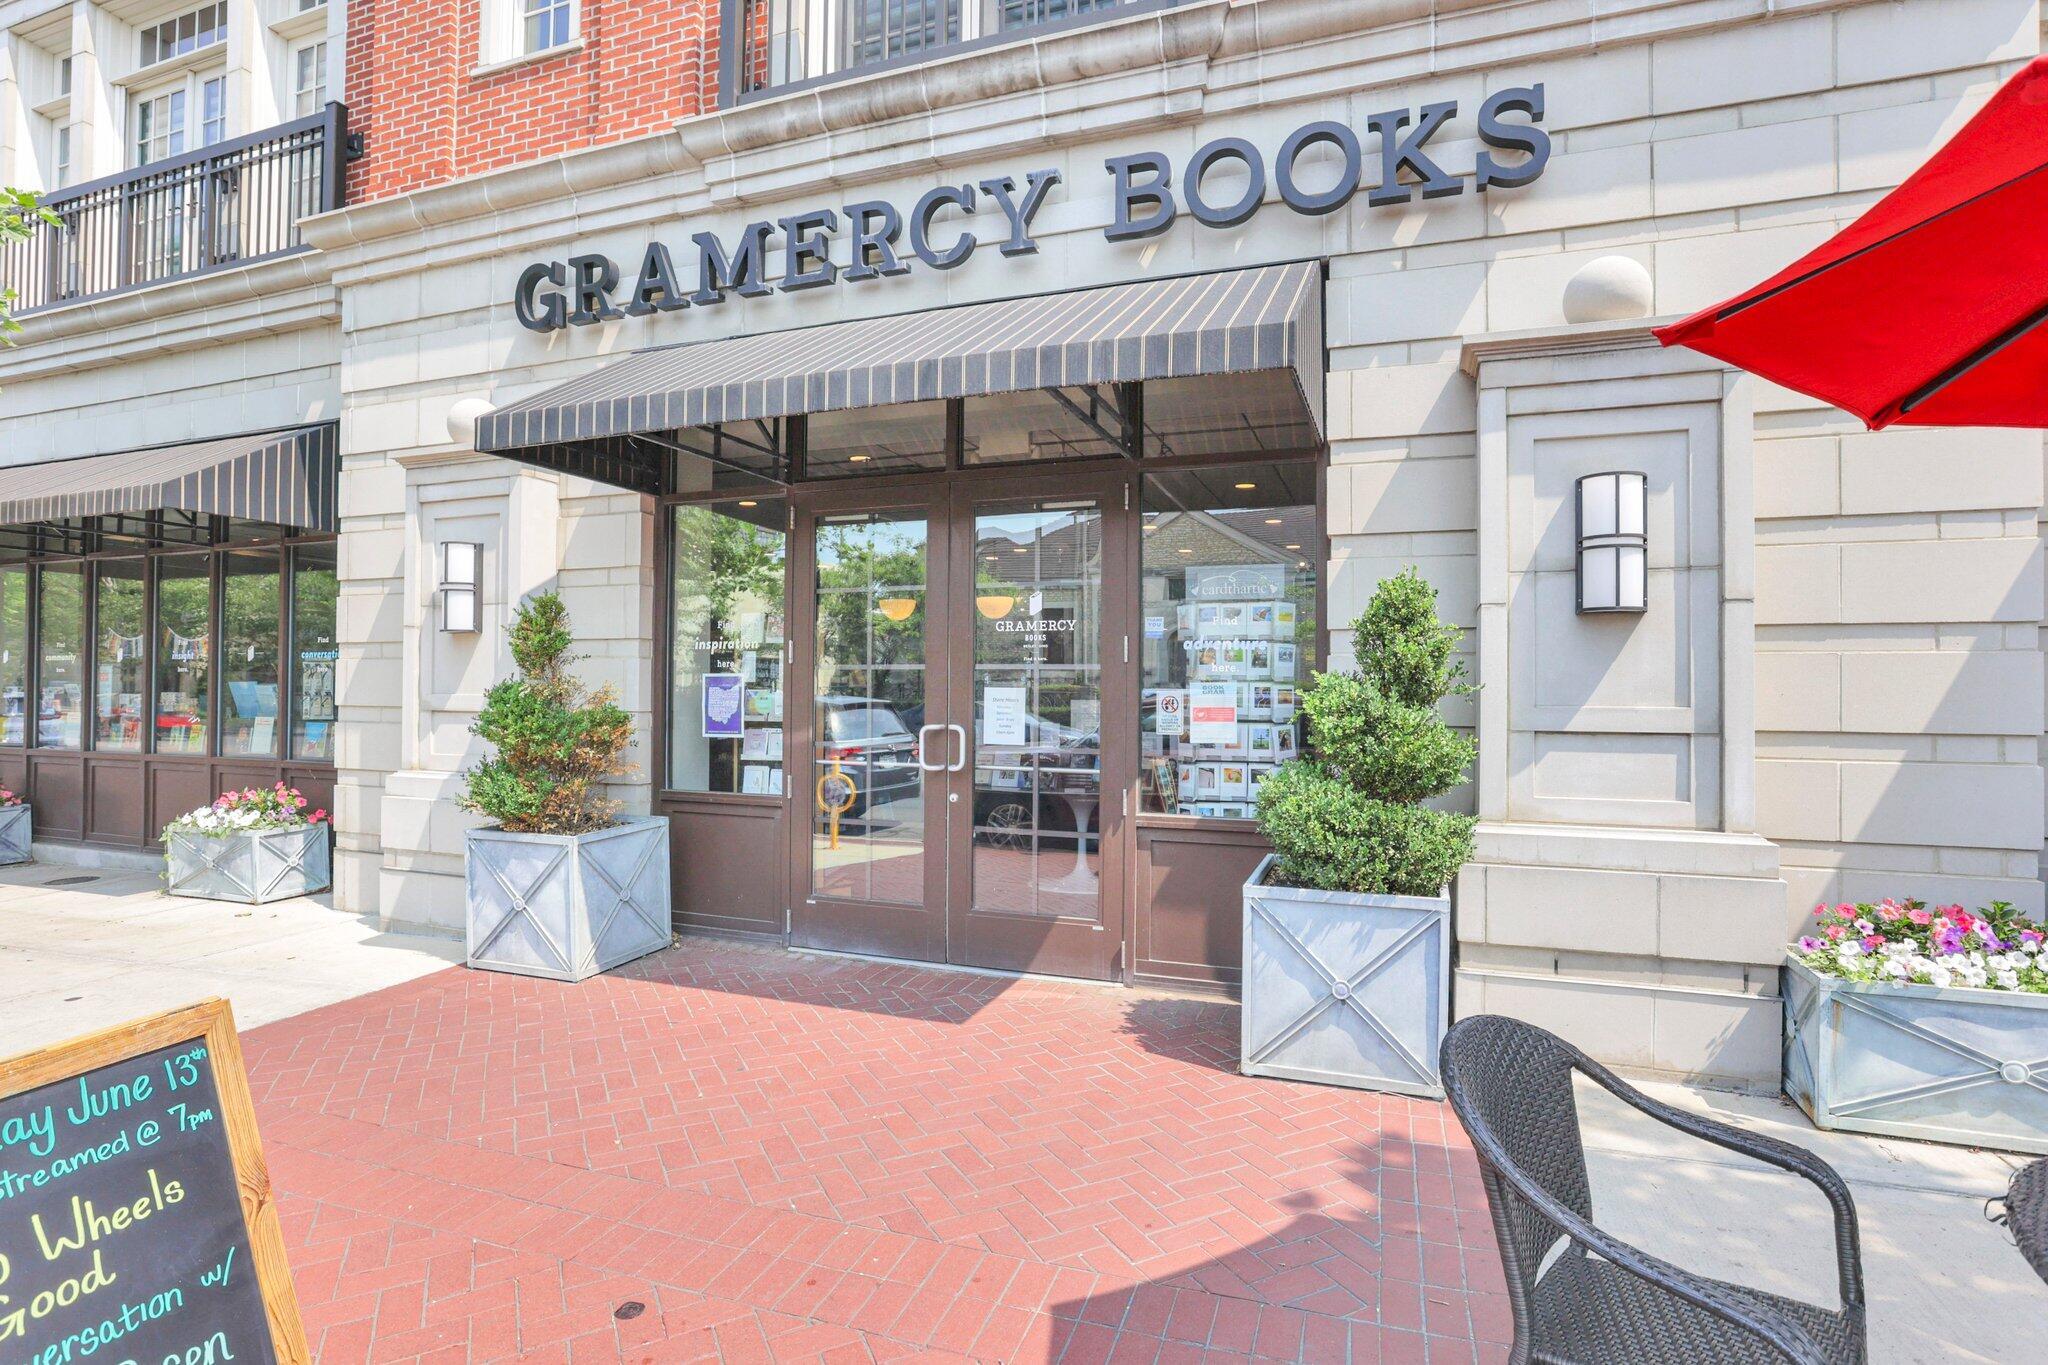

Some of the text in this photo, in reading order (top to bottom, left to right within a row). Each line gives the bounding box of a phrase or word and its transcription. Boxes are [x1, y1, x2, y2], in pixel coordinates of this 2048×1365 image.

[515, 83, 1552, 333] GRAMERCY BOOKS
[995, 620, 1077, 632] GRAMERCY
[1212, 616, 1239, 625] Find
[694, 636, 759, 654] inspiration
[1024, 634, 1047, 642] BOOKS
[1183, 635, 1268, 651] adventure
[1211, 661, 1240, 672] here.
[0, 1048, 206, 1156] ay June 13th
[136, 1120, 161, 1146] @
[167, 1103, 213, 1132] 7pm
[31, 1168, 186, 1261] Wheels
[200, 1246, 235, 1287] w/
